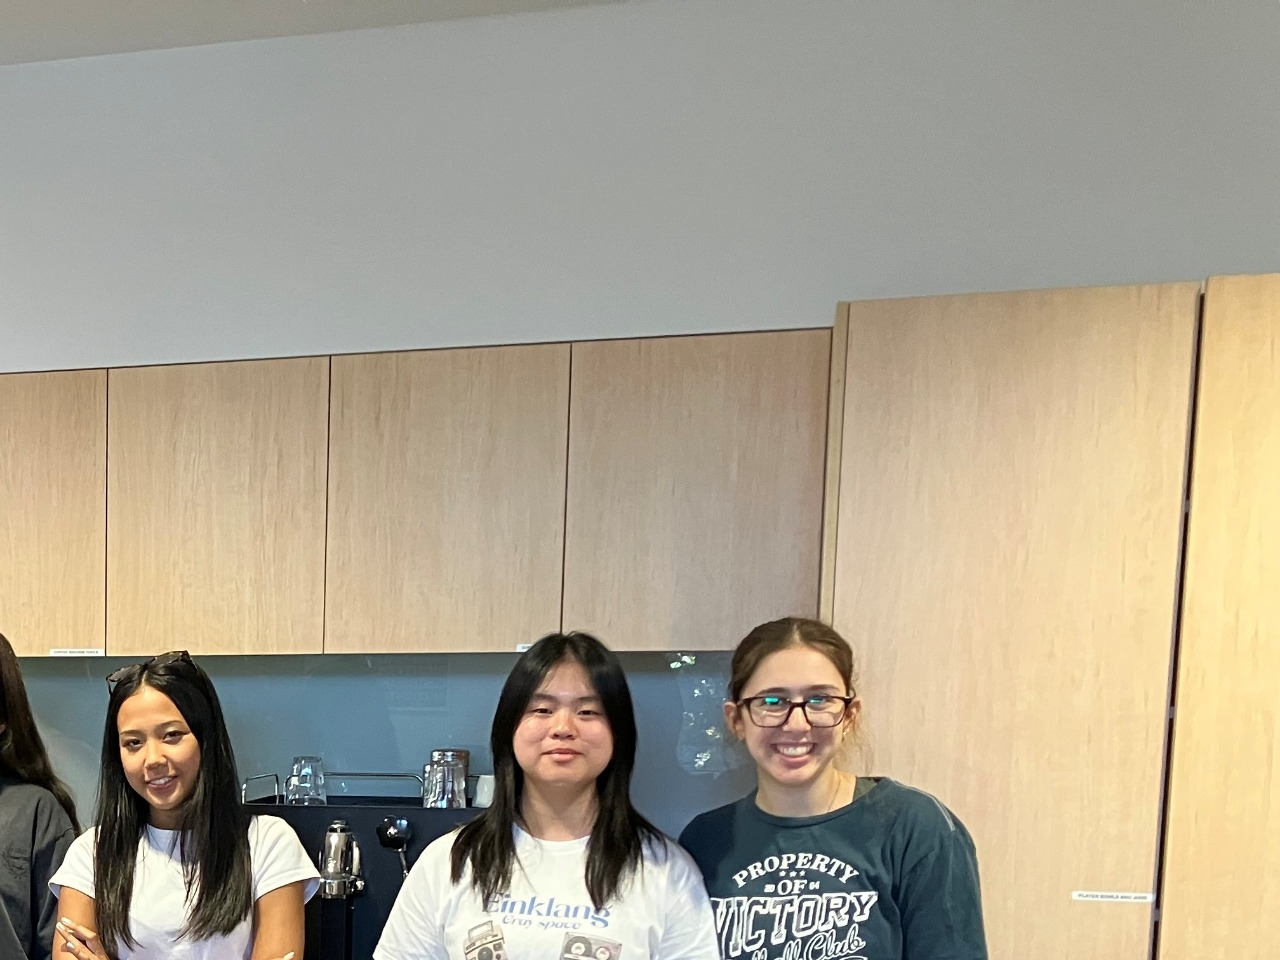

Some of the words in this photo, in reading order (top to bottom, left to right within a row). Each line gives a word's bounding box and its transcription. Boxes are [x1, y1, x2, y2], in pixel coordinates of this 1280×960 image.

[731, 852, 860, 889] PROPERTY
[777, 879, 808, 896] OF
[536, 919, 582, 930] space
[710, 891, 878, 958] VICTORY
